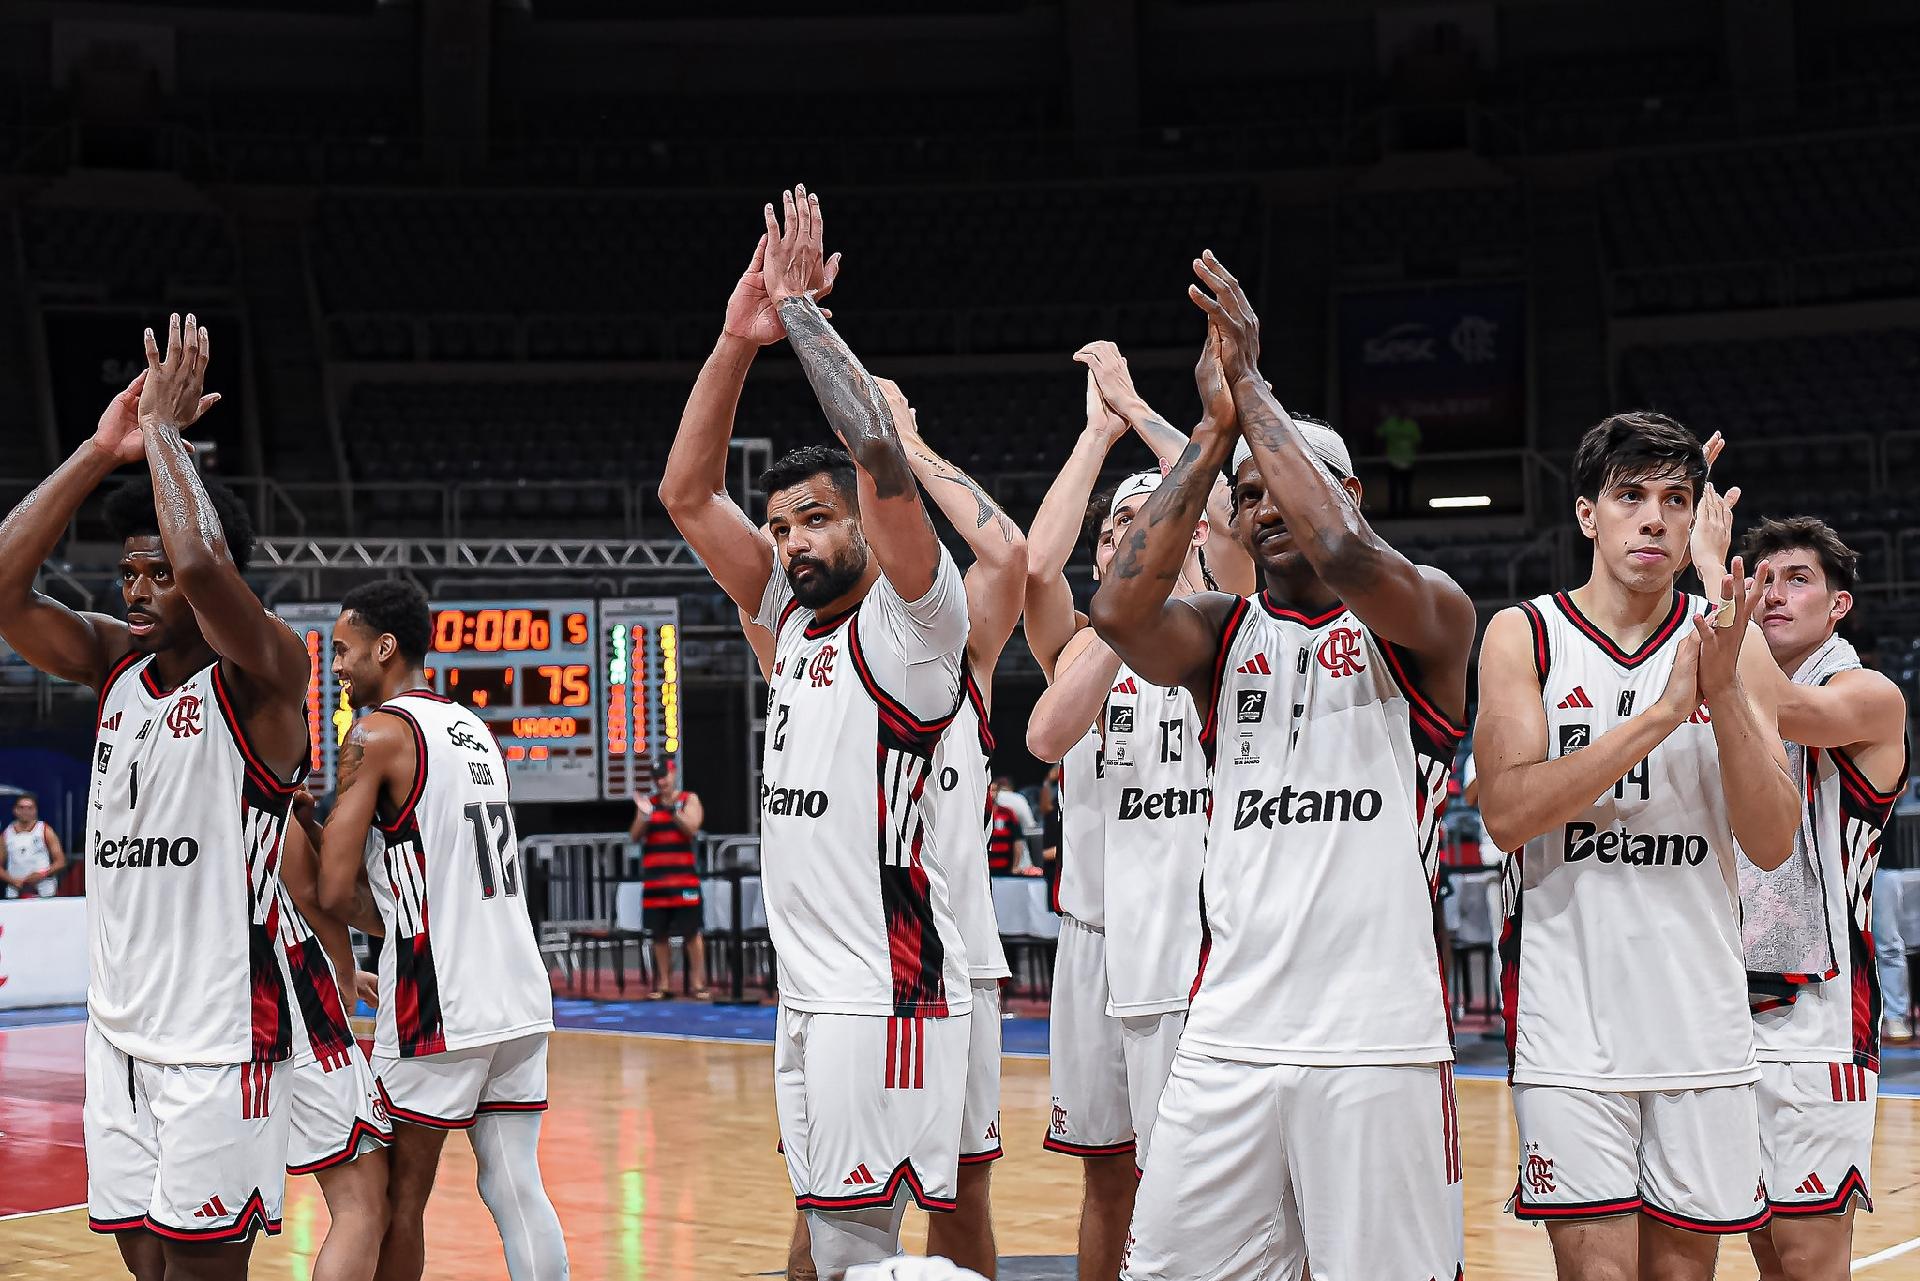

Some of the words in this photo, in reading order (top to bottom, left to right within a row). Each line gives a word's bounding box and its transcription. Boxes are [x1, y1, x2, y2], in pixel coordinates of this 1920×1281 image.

[537, 664, 590, 707] 75
[1159, 718, 1183, 763] 13
[129, 761, 139, 810] 1
[467, 761, 495, 785] IGOR
[1118, 787, 1208, 820] Betan
[1233, 785, 1383, 831] Betano
[463, 801, 519, 900] 12
[1563, 820, 1709, 867] Betano
